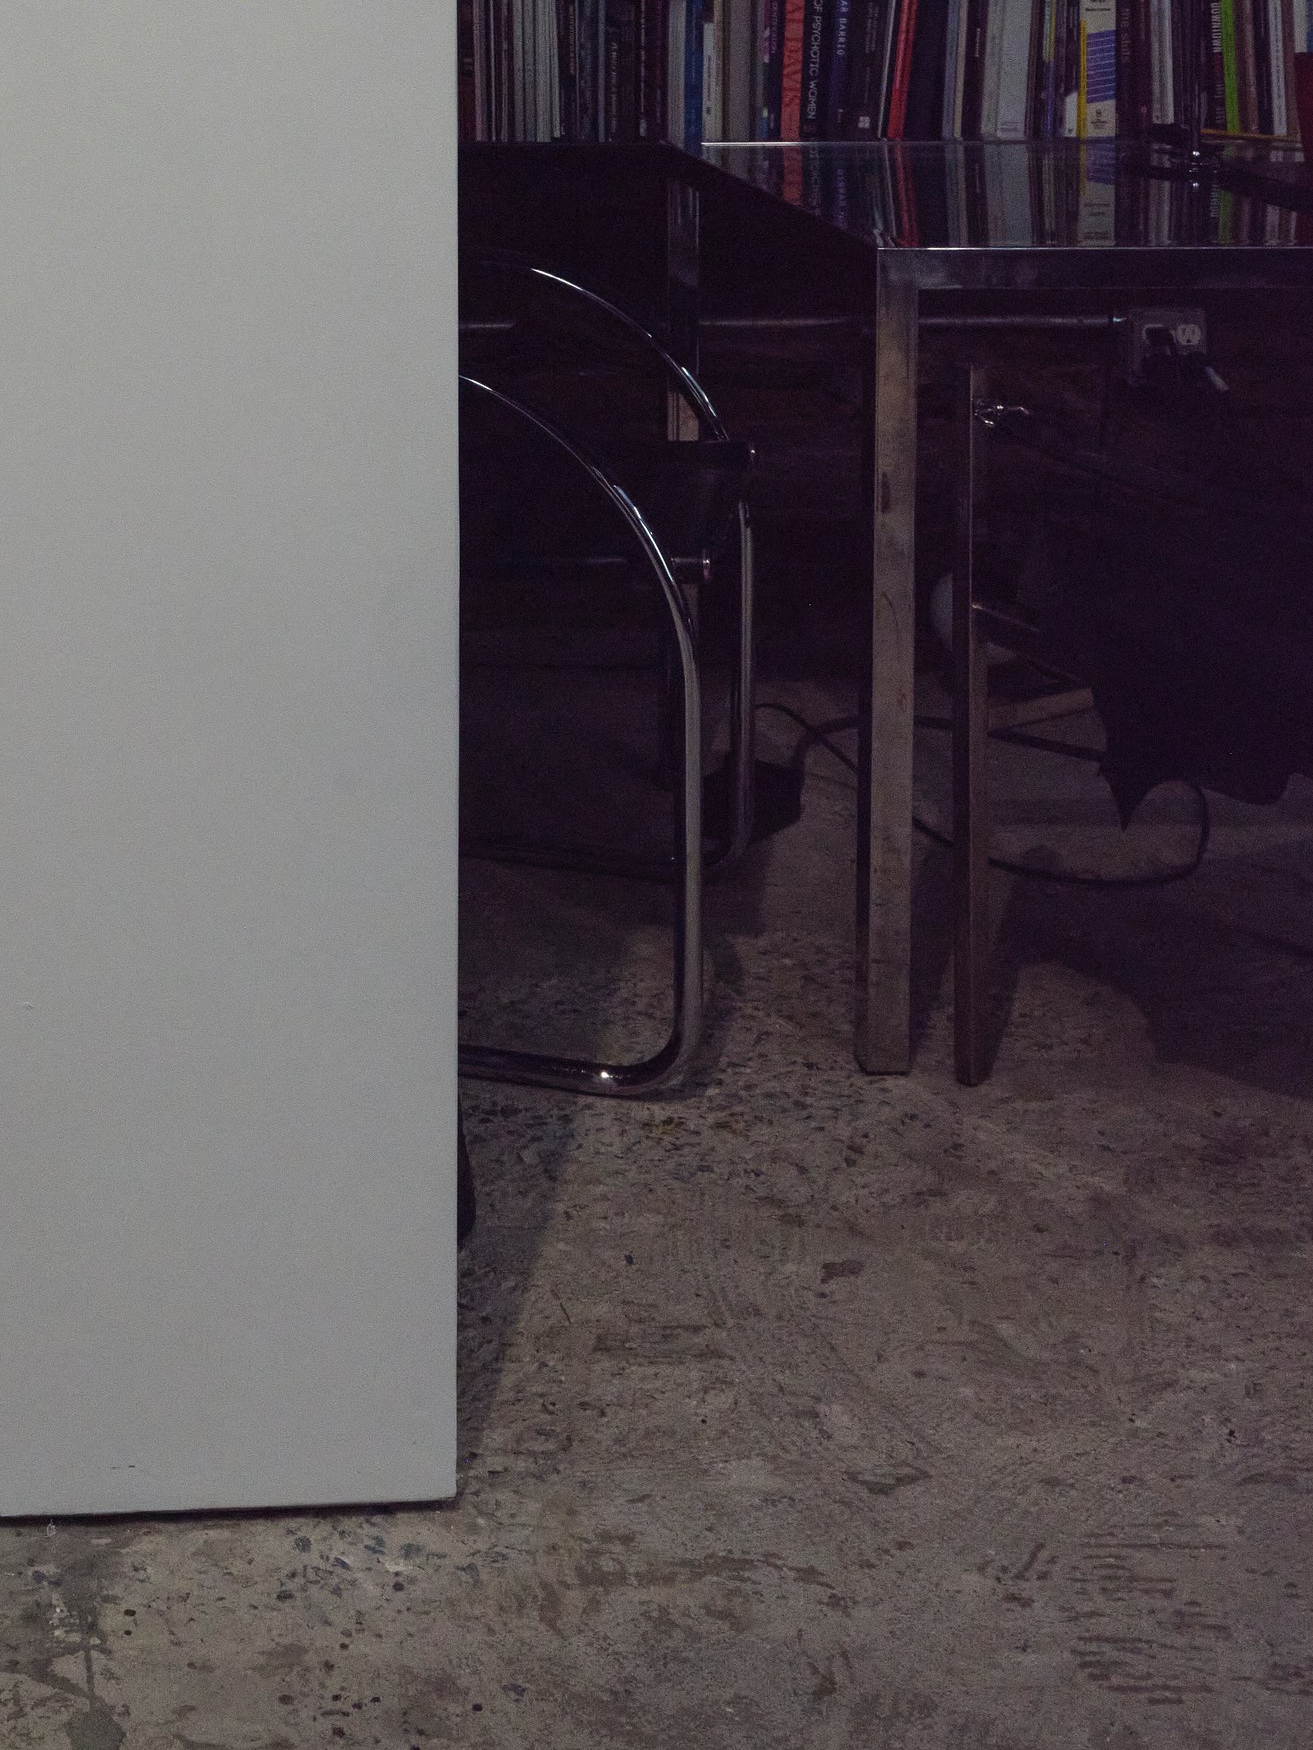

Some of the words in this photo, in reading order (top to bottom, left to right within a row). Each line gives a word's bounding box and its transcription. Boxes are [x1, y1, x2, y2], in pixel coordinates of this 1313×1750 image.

[808, 15, 822, 75] PSYCHOTIC
[836, 17, 849, 56] BARRIO
[1210, 2, 1222, 53] DOWNTOWN
[783, 37, 804, 109] DAVIS
[806, 79, 819, 119] WOMEN
